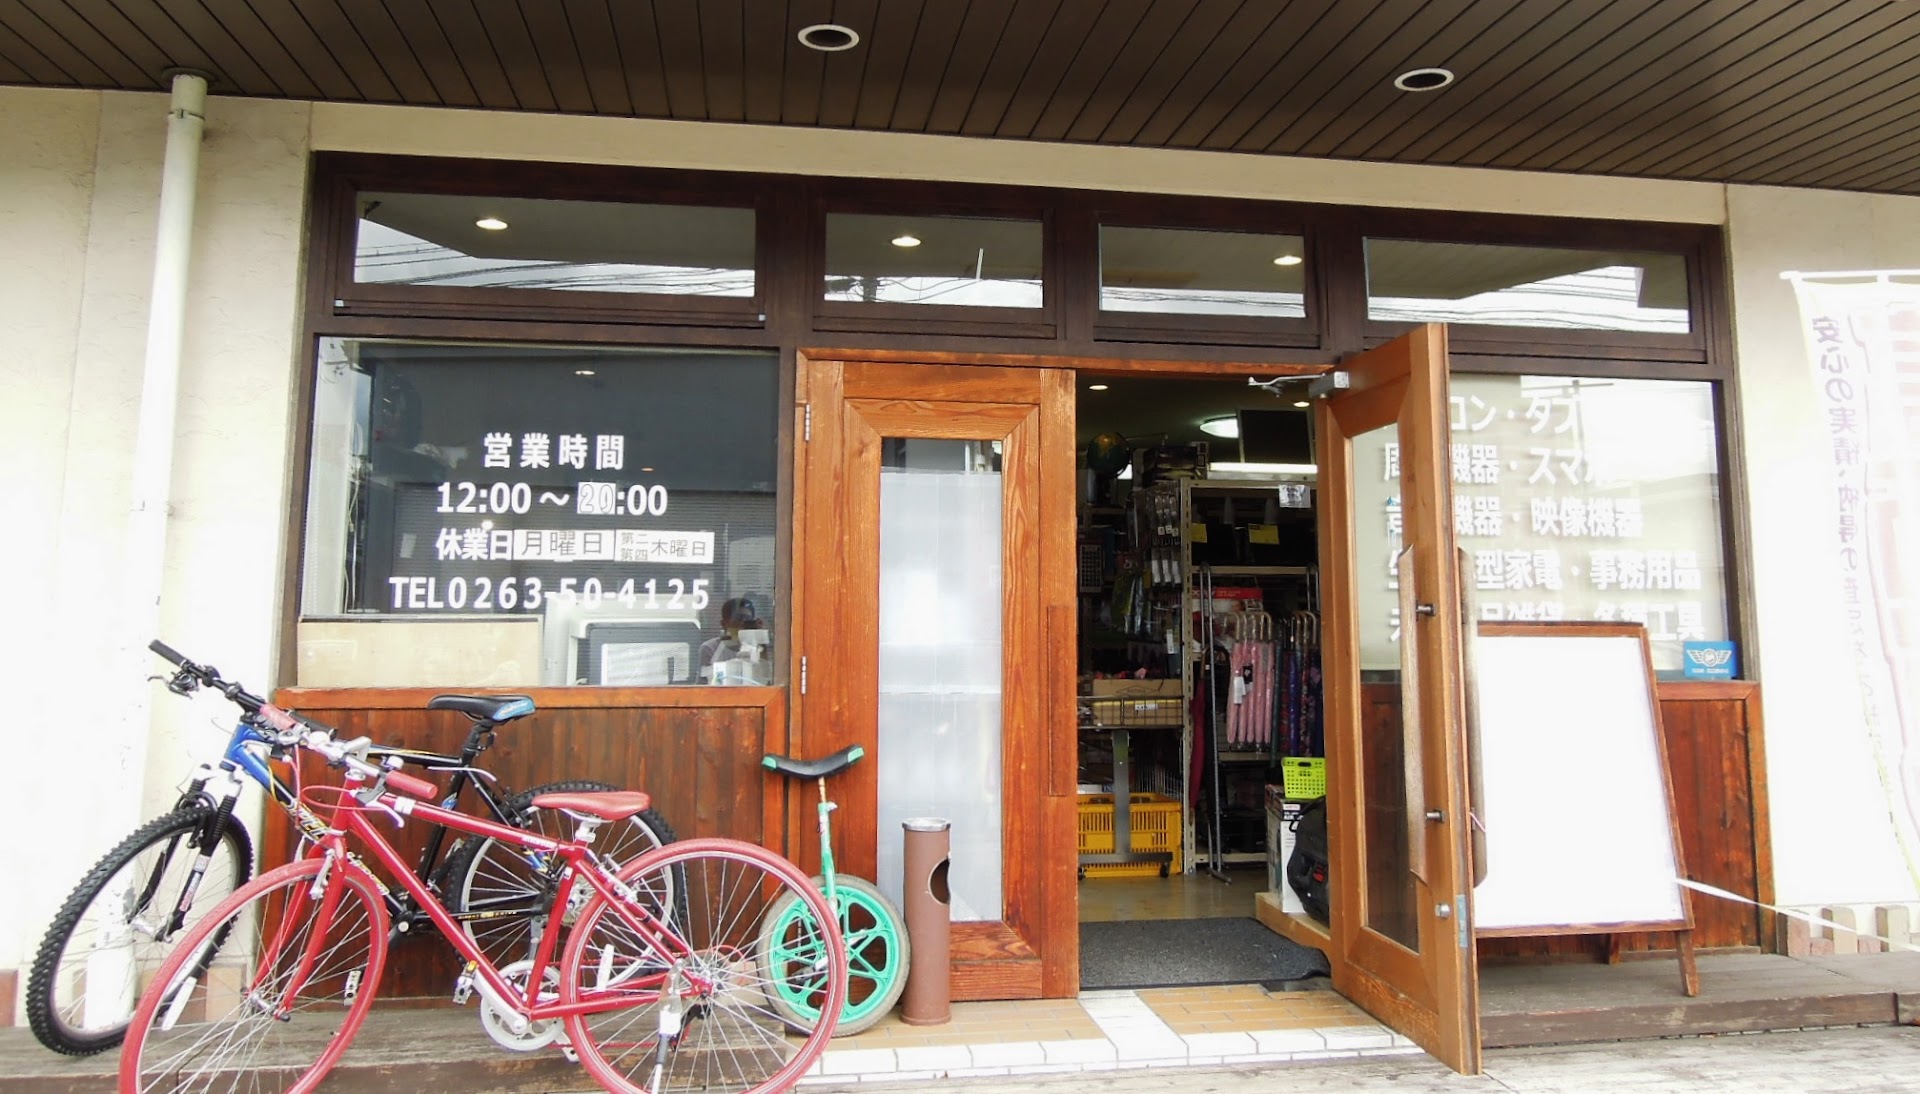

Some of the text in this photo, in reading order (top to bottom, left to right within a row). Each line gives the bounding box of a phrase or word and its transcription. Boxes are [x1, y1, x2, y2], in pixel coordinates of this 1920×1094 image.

[484, 432, 624, 470] 営業時間
[436, 528, 513, 560] 休業日
[522, 531, 602, 557] 月曜日
[651, 539, 706, 558] 木曜日
